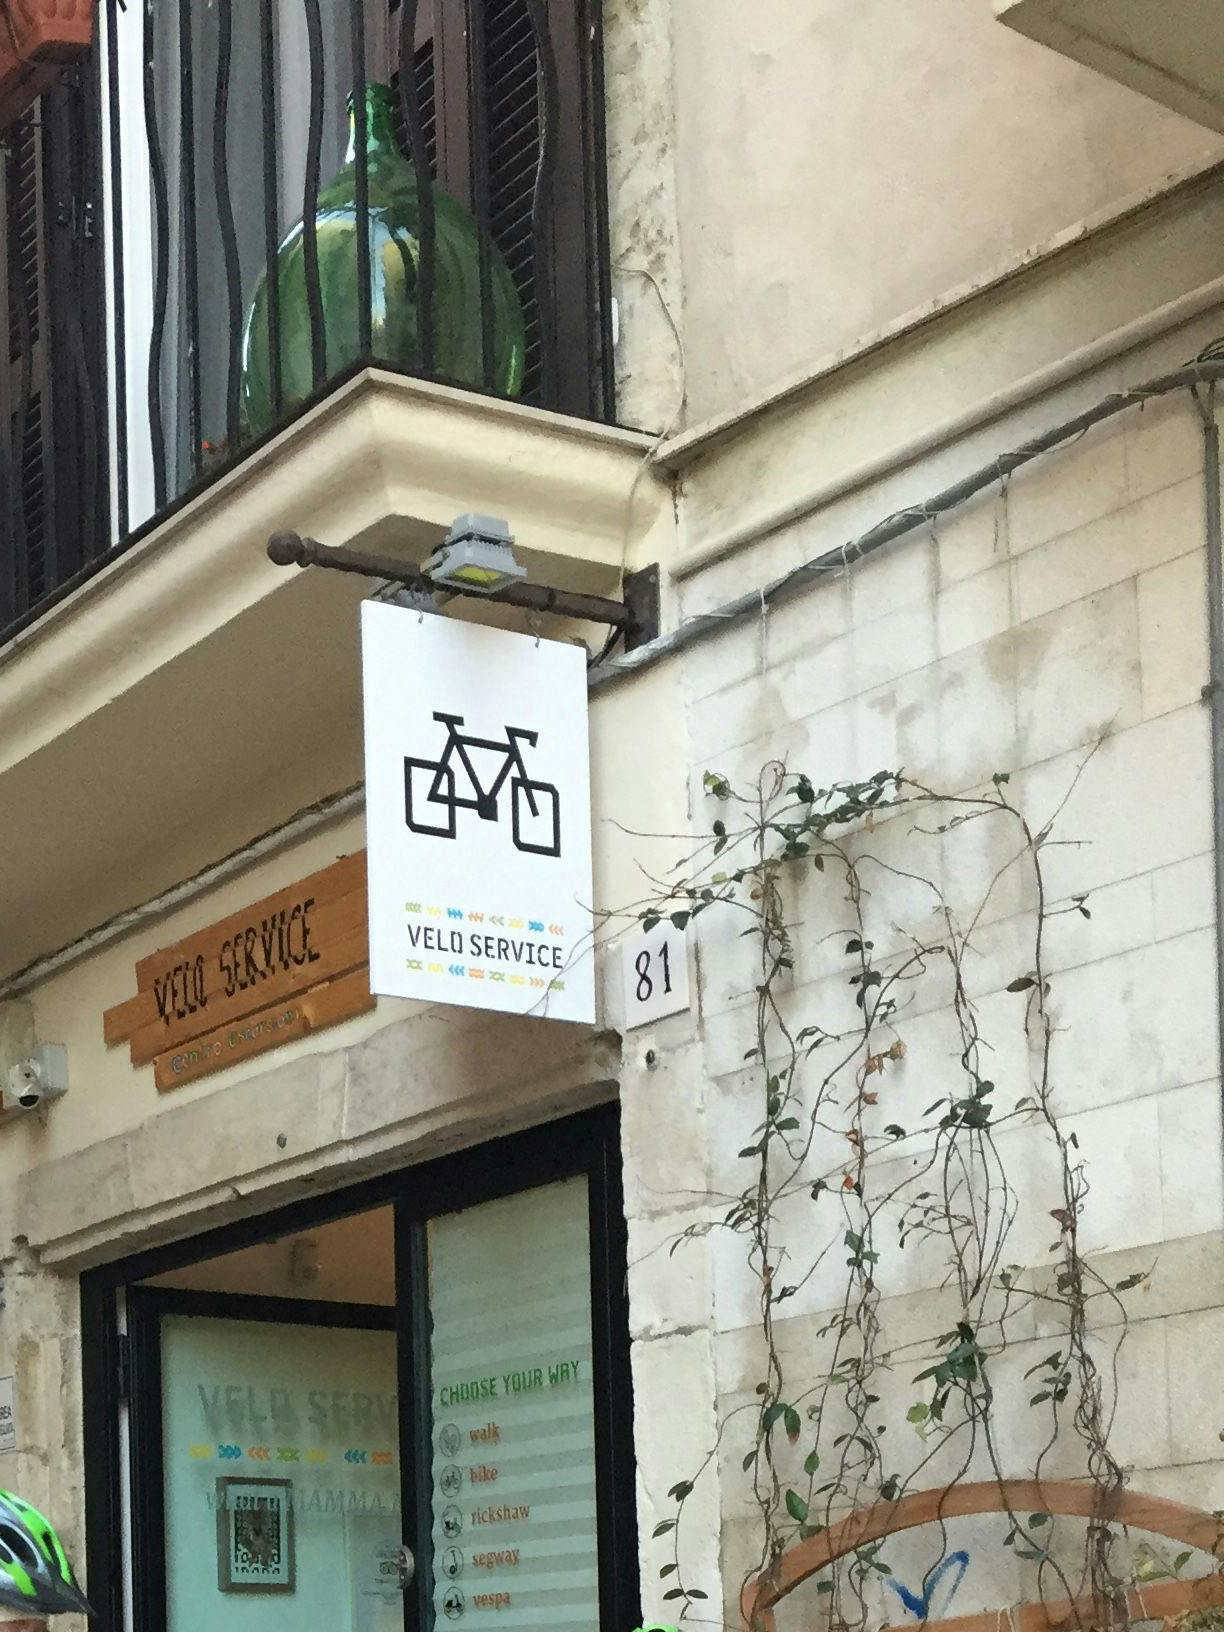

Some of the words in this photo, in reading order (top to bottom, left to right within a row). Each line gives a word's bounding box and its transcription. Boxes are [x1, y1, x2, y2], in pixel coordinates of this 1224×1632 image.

[407, 924, 463, 954] VELO
[470, 933, 563, 969] SERVICE
[153, 954, 208, 1026] VELO
[219, 897, 321, 998] SERVICE
[634, 941, 672, 1002] 81
[439, 1376, 498, 1408] CHOOSE
[503, 1368, 543, 1396] YOUR
[547, 1360, 580, 1385] WAY
[469, 1421, 501, 1442] walk
[470, 1465, 499, 1484] bike
[471, 1504, 530, 1526] rickshaw
[472, 1548, 521, 1570] segway
[472, 1591, 512, 1612] vespa
